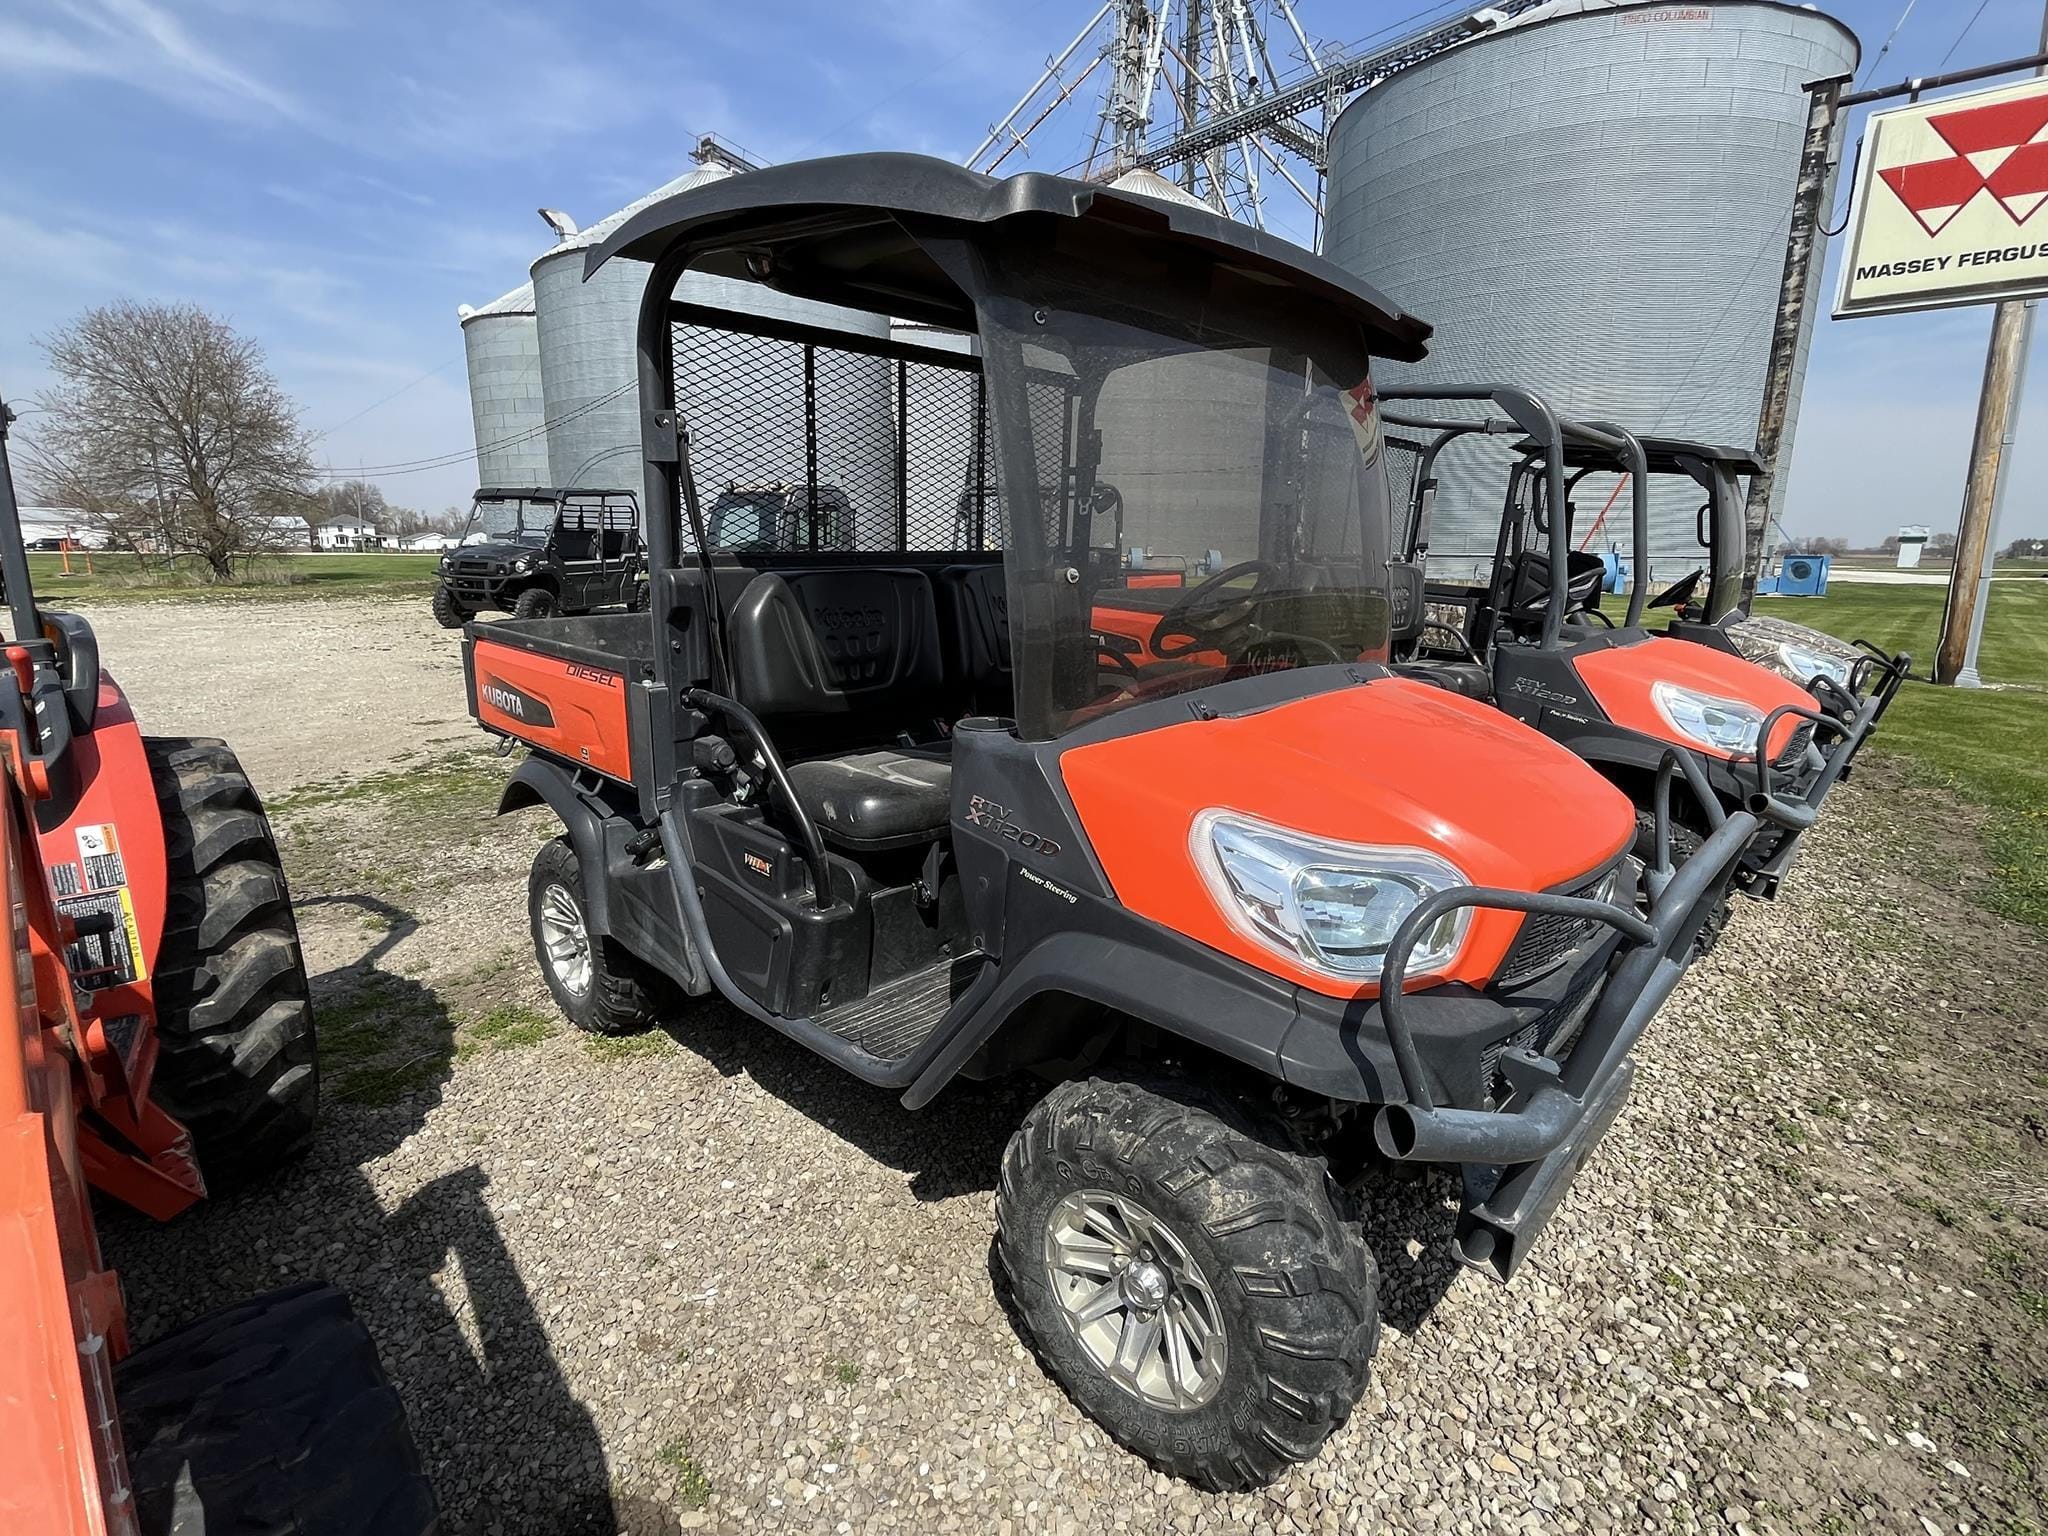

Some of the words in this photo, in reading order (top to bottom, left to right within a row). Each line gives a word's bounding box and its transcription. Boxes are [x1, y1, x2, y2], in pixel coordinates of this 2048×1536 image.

[1653, 9, 1709, 22] COLUMBIAN
[1856, 255, 1952, 280] MASSEY
[565, 663, 618, 689] DIESEL
[481, 682, 525, 719] KUBOTA
[970, 794, 1014, 820] RTV
[964, 806, 1062, 858] X1120D
[1019, 867, 1045, 886] Power
[1043, 880, 1078, 904] Steering
[124, 915, 141, 959] CAUTION
